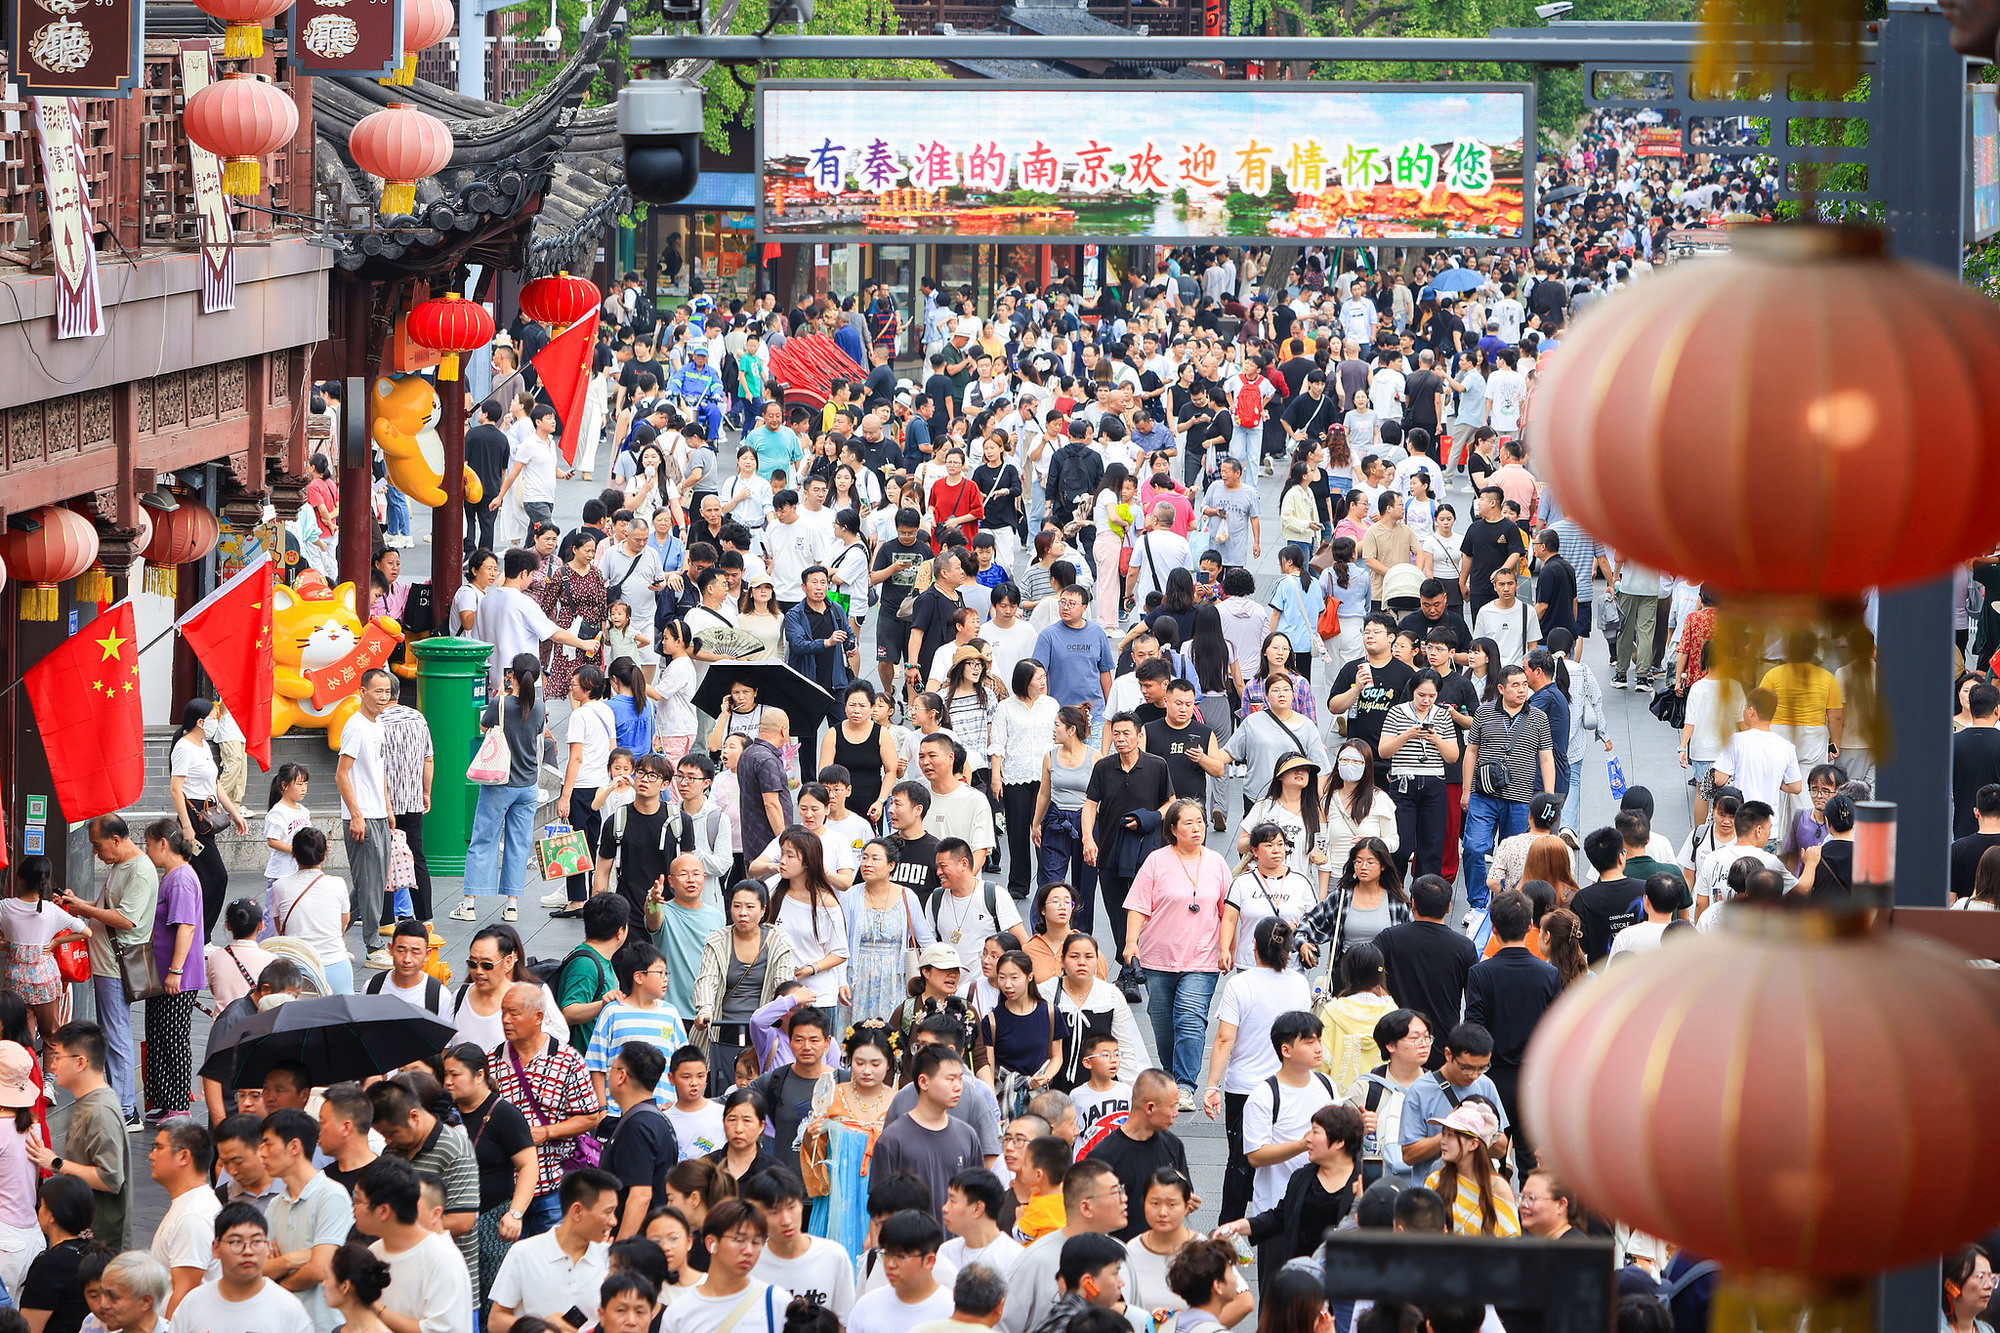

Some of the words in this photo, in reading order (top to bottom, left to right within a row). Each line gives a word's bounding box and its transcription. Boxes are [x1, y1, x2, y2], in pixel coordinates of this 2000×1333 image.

[810, 137, 1488, 190] 有秦淮的南京欢迎有情怀的您
[327, 639, 382, 691] 金榜题名
[1361, 687, 1386, 702] Gap
[1170, 741, 1184, 755] 96
